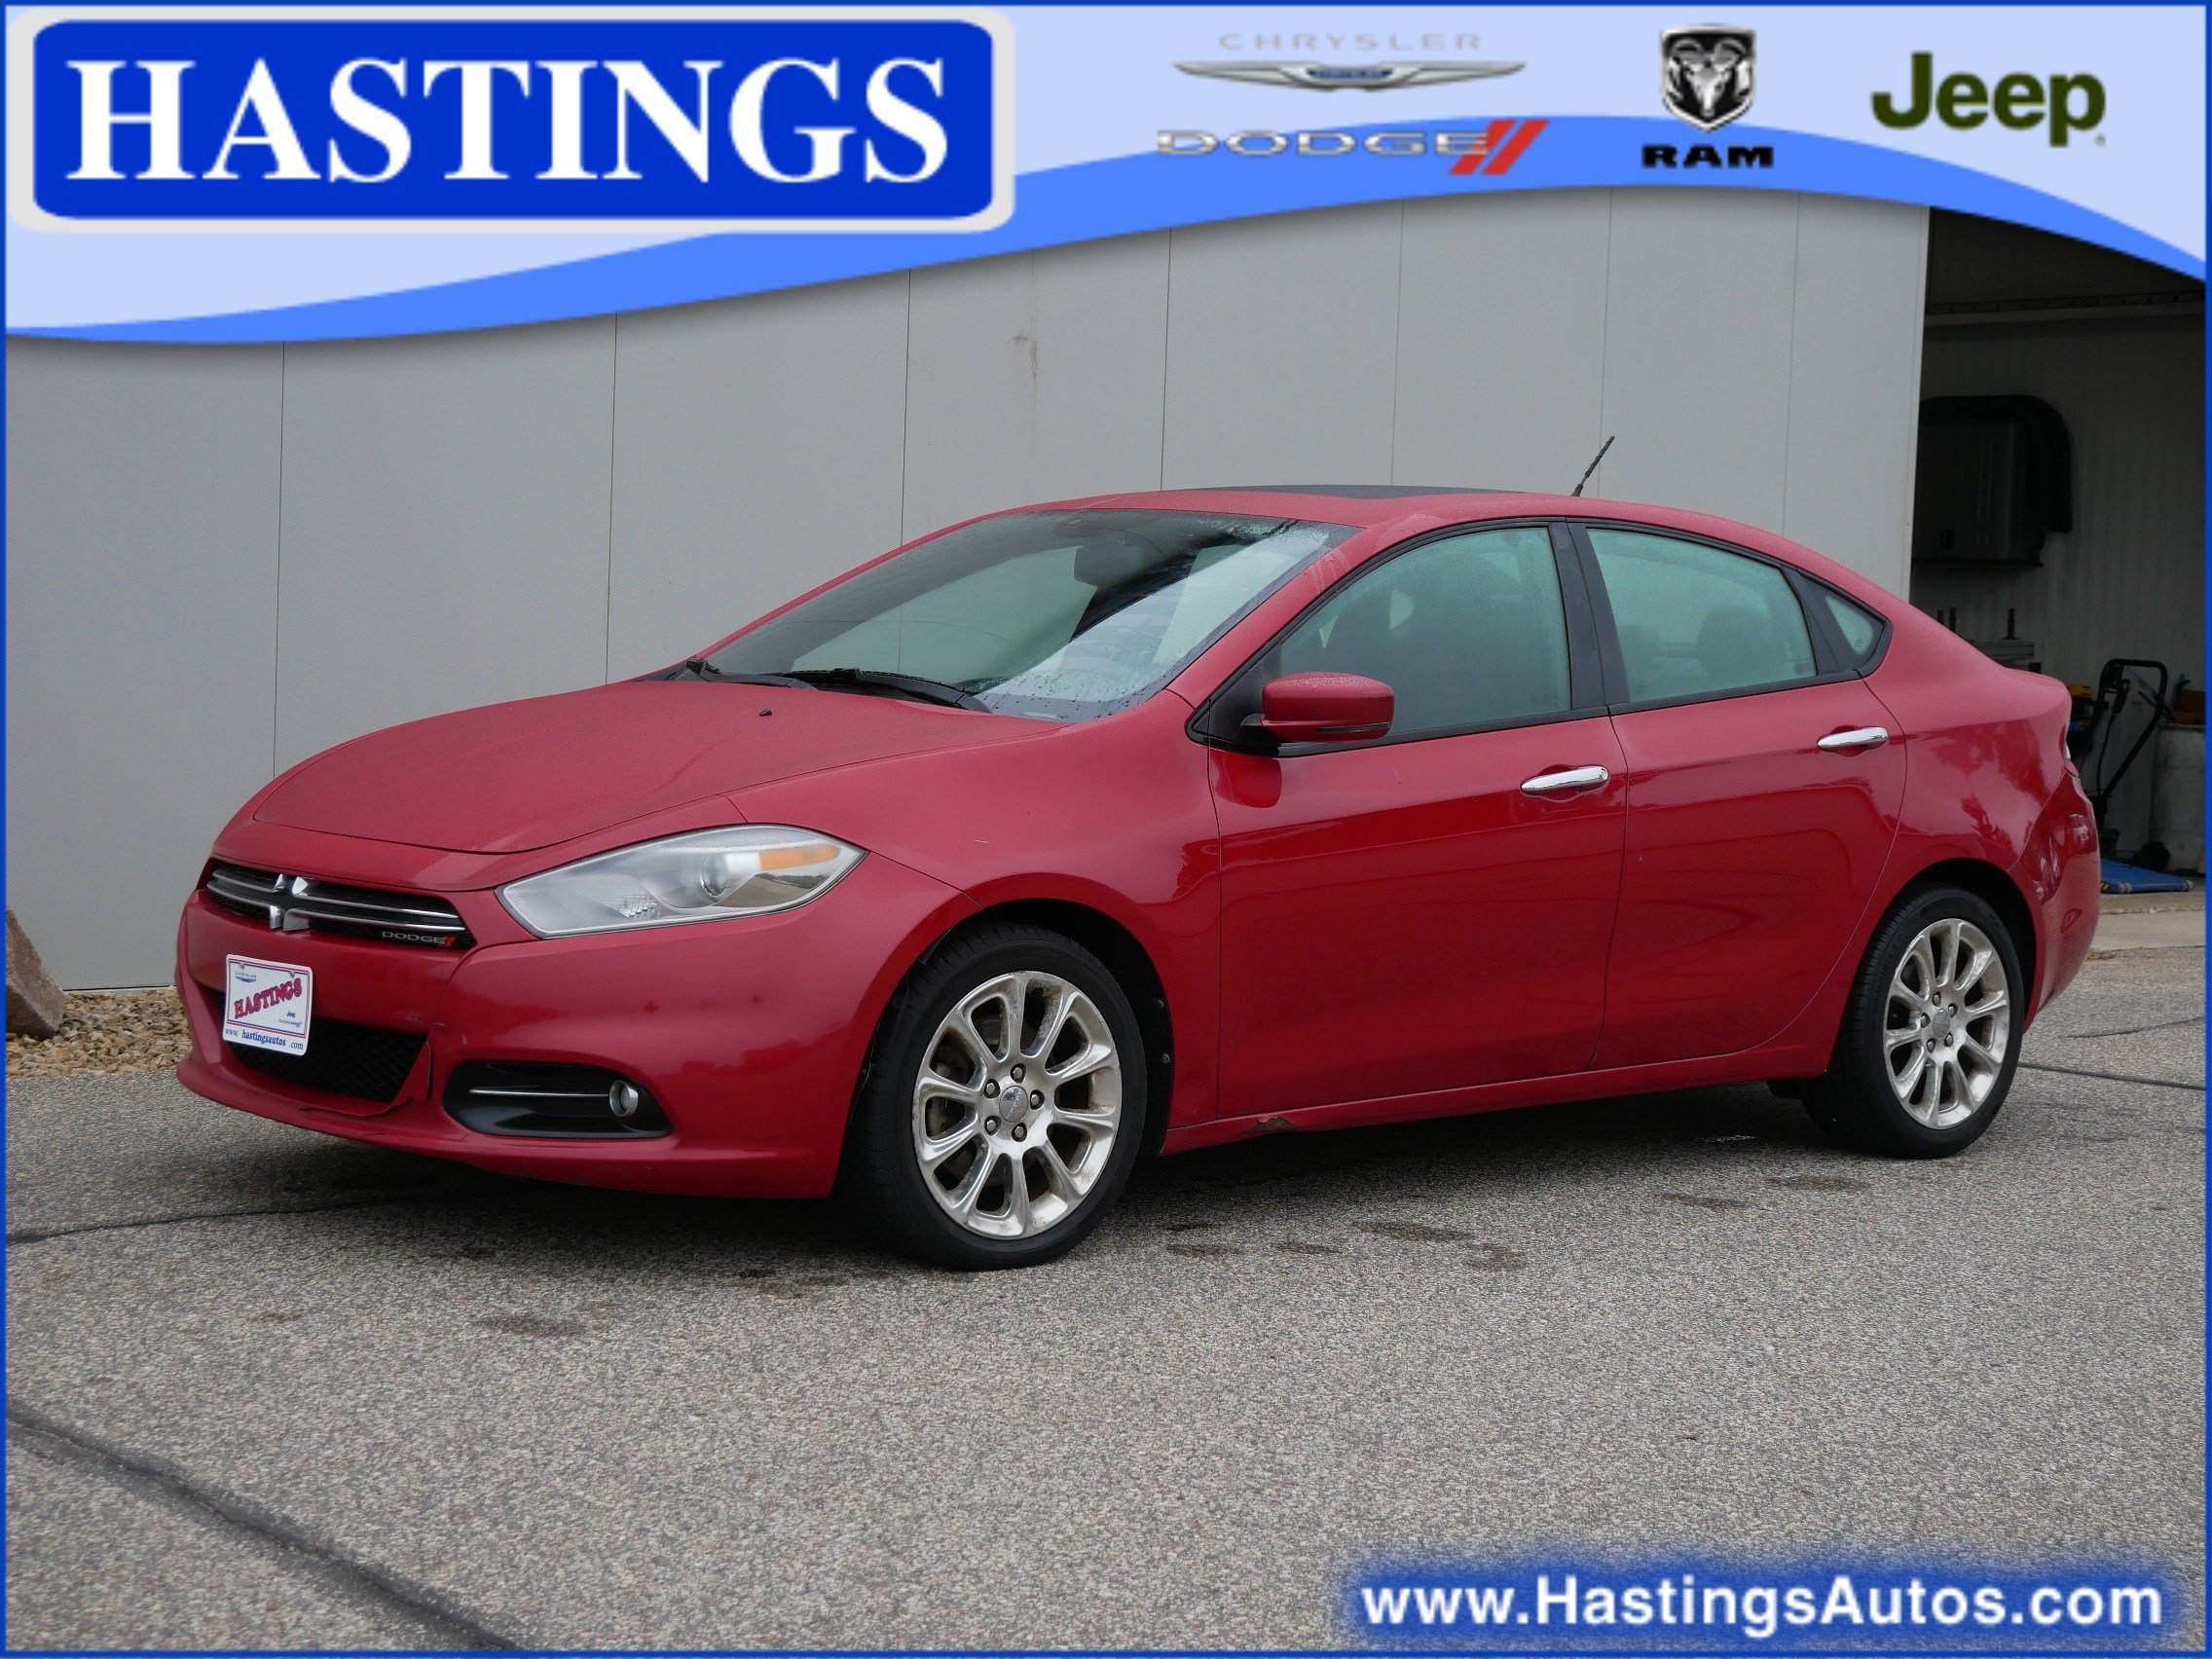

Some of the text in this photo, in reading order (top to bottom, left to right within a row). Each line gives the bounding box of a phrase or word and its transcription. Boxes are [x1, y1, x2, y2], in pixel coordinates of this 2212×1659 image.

[382, 931, 446, 943] DODGE
[234, 977, 302, 1019] HASTINGS
[241, 1029, 286, 1046] hastingsautos
[288, 1041, 304, 1050] .com
